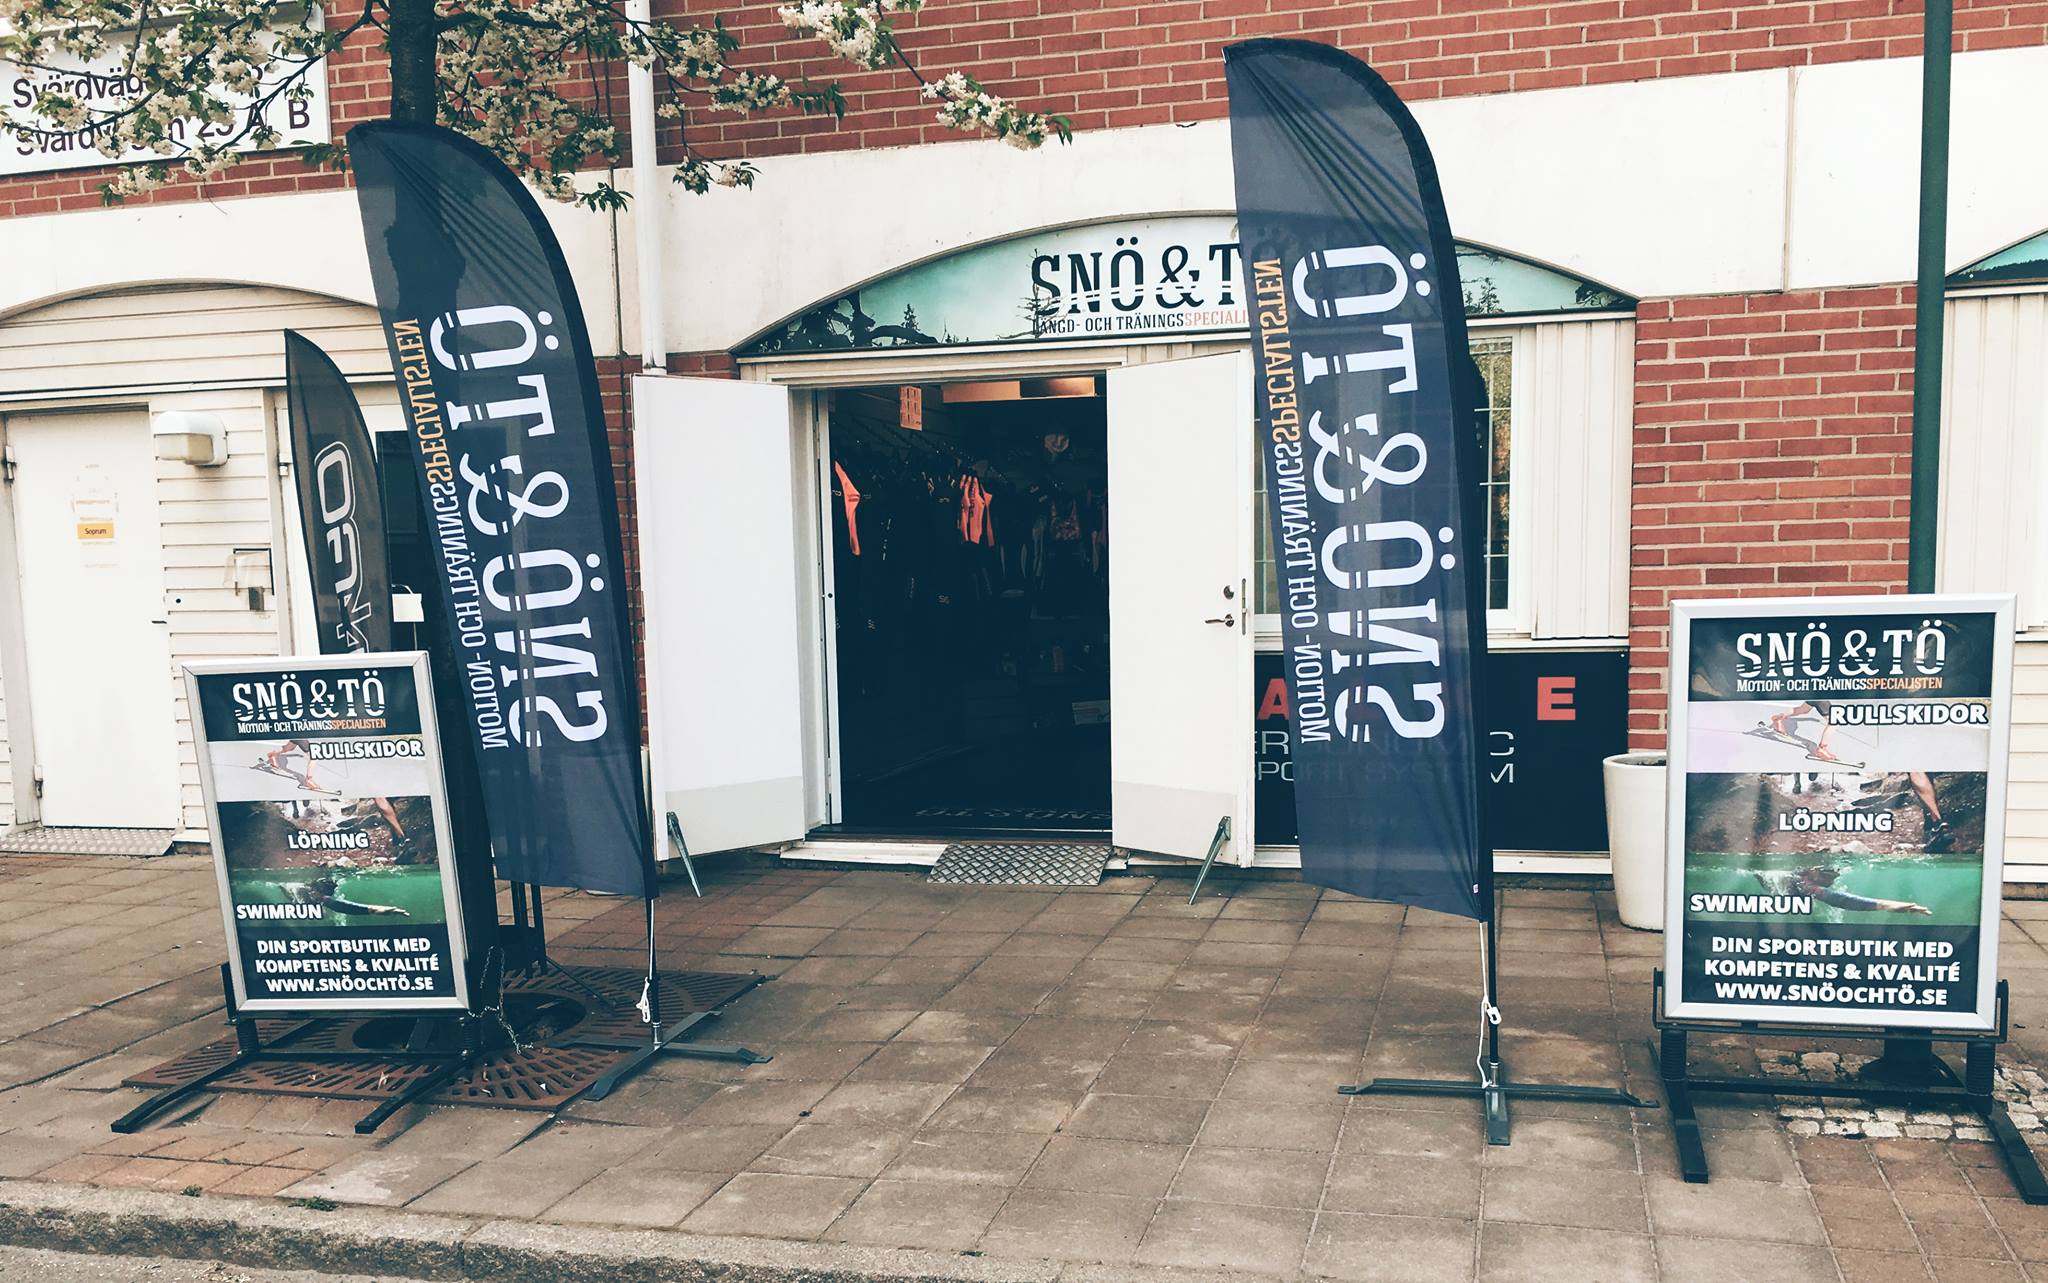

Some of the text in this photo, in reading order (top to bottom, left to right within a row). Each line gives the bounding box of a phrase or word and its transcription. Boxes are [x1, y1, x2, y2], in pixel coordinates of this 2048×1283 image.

[288, 99, 310, 130] B
[1085, 316, 1113, 332] OCH
[1116, 309, 1249, 330] TRÄNINGSSPECIALI
[1787, 679, 1809, 692] OCH
[1828, 703, 1989, 726] RULLSKIDOR
[274, 721, 291, 733] OCH
[309, 739, 425, 761] RULLSKIDOR
[1779, 810, 1893, 832] LÖPNING
[288, 831, 369, 850] LÖPNING
[236, 903, 323, 920] SWIMRUN
[1689, 893, 1812, 915] SWIMRUN
[257, 937, 431, 954] DIN SPORTBUTIK MED
[1711, 936, 1954, 958] DIN SPORTBUTIK MED
[255, 953, 440, 974] KOMPETENS & KVALITÉ
[1704, 958, 1961, 983] KOMPETENS & KVALITÉ
[265, 974, 434, 992] WWW.SNÖOCHTÖ.SE
[1714, 980, 1949, 1006] WWW.SNÖOCHTÖ.SE
